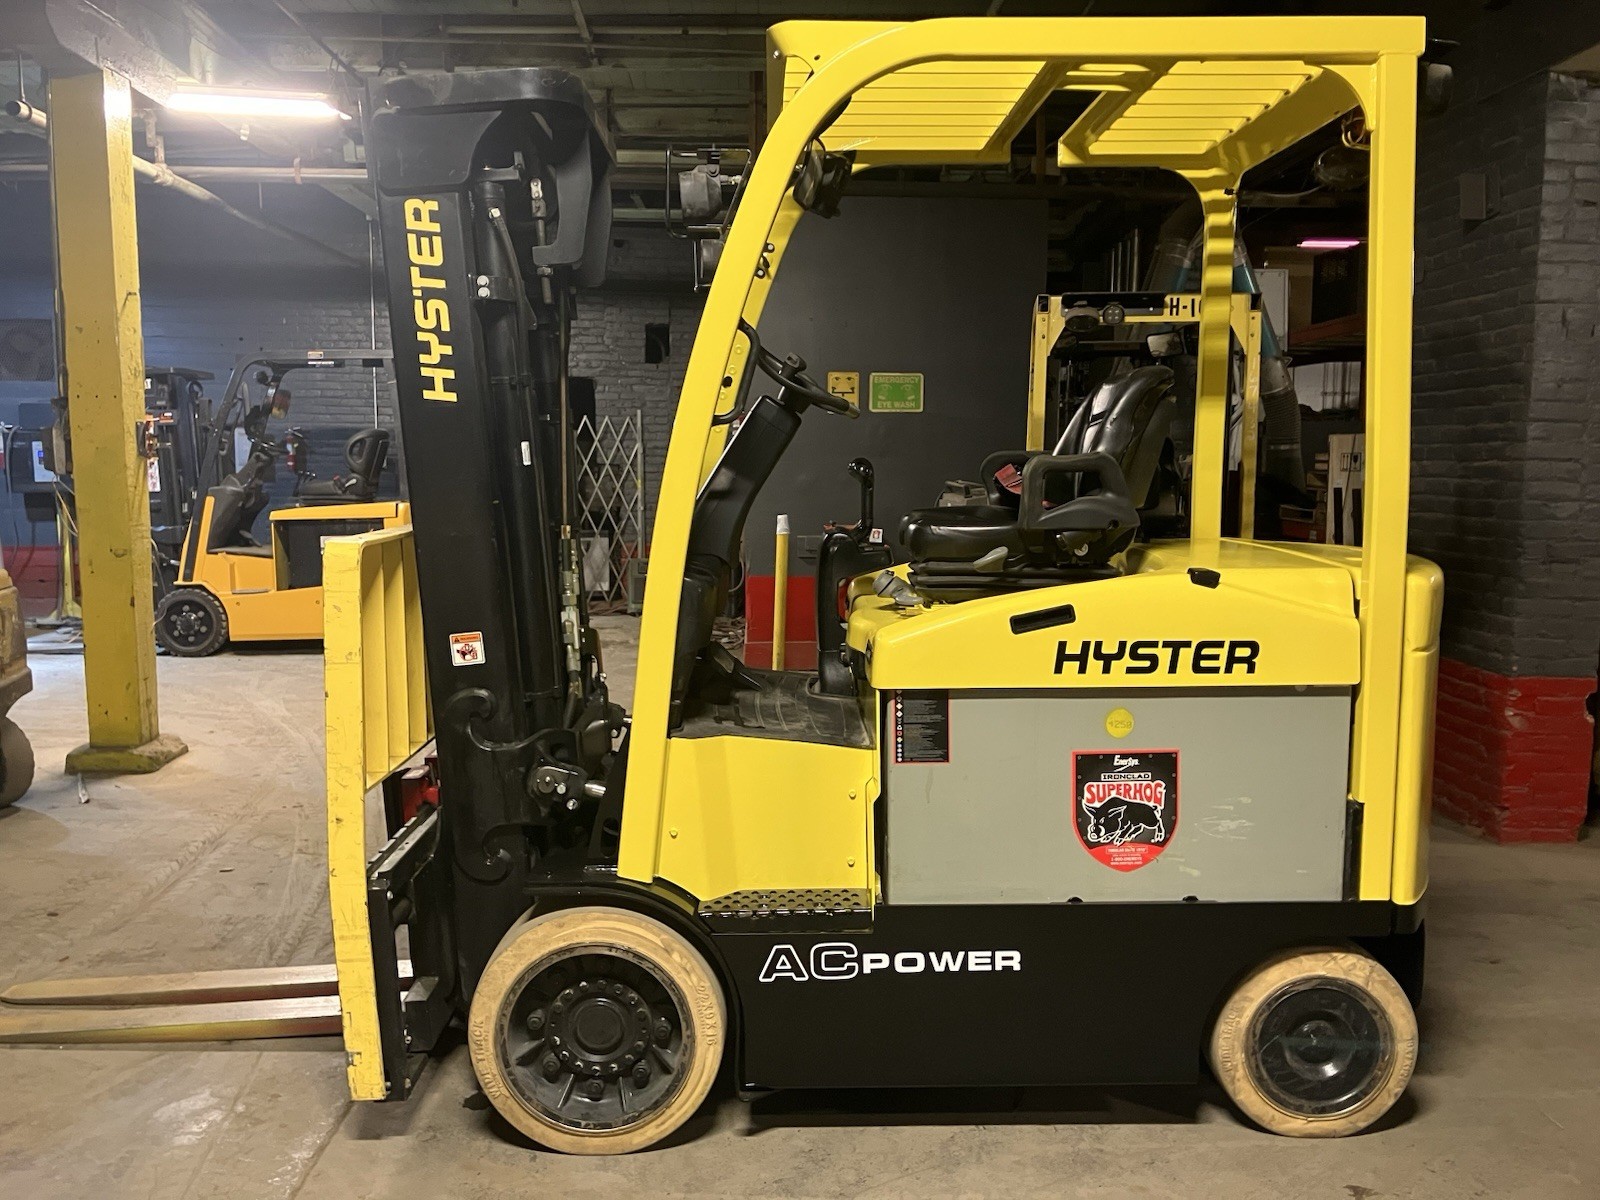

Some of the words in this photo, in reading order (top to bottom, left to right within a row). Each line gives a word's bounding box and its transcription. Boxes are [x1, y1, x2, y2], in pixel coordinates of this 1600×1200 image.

[404, 198, 457, 402] HYSTER
[1170, 298, 1201, 317] H-1
[874, 376, 920, 384] EMERGENCY
[1053, 641, 1260, 674] HYSTER
[1085, 780, 1166, 808] SUPERHOG
[759, 943, 859, 982] AC
[862, 950, 1021, 974] POWER
